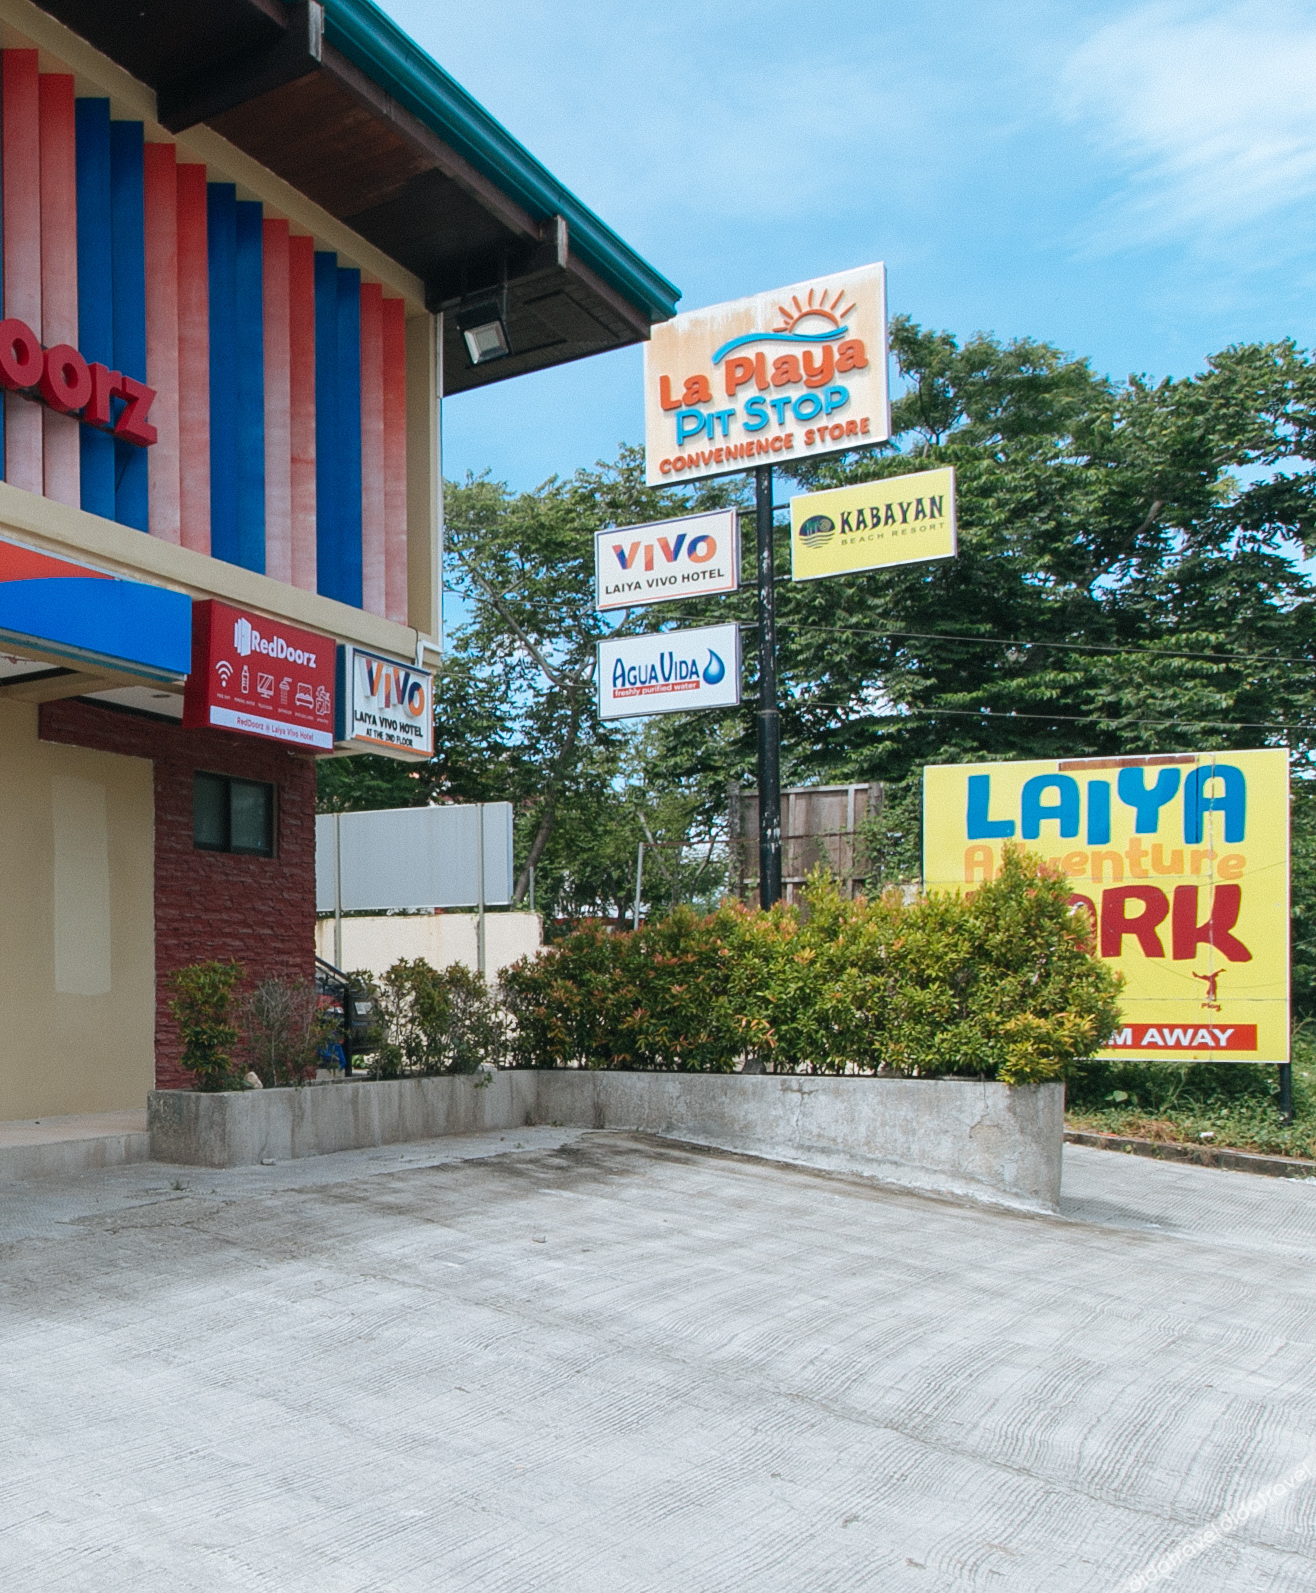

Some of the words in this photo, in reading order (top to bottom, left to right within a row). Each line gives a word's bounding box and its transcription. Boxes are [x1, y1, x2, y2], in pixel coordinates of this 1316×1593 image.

[659, 373, 712, 412] La
[725, 337, 869, 398] Playa
[743, 385, 850, 433] STOP
[659, 433, 794, 475] CONVENIENCE
[804, 417, 870, 446] STORE
[840, 495, 945, 534] KABAYAN
[841, 533, 884, 545] BEACH
[892, 522, 945, 537] RESORT
[612, 533, 717, 572] VIVO
[605, 581, 642, 595] LAIYA
[646, 575, 678, 588] VIVO
[682, 568, 725, 583] HOTEL
[251, 630, 317, 669] RedDoorz
[360, 658, 425, 718] VIVO
[615, 688, 641, 697] freshly
[642, 684, 672, 695] purified
[674, 682, 697, 690] water
[236, 716, 264, 730] RedDoorz
[354, 709, 377, 726] LAIYA
[379, 716, 398, 731] VIVO
[399, 722, 423, 738] HOTEL
[374, 729, 383, 740] THE
[396, 735, 413, 747] FLOOR
[966, 764, 1247, 846] LAIYA
[1201, 1002, 1222, 1013] Play
[1140, 1028, 1235, 1046] AWAY
